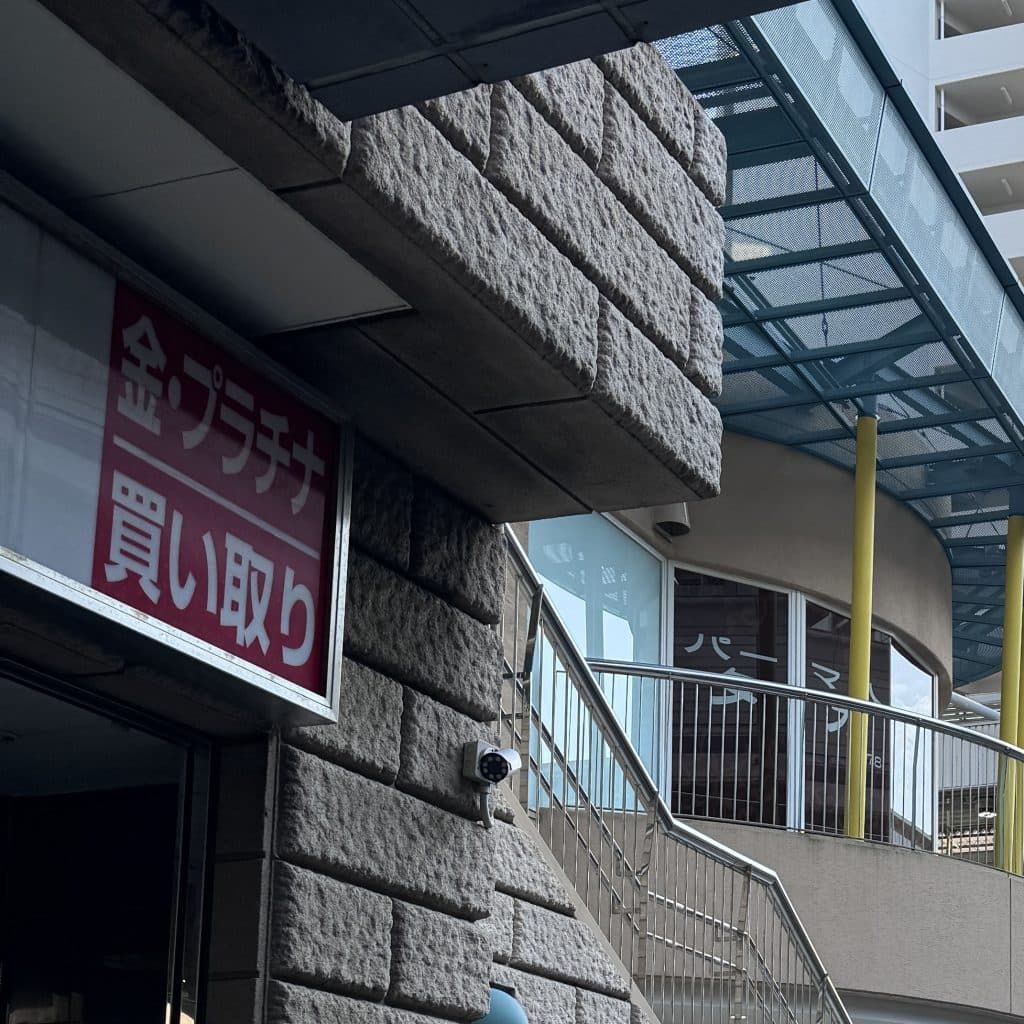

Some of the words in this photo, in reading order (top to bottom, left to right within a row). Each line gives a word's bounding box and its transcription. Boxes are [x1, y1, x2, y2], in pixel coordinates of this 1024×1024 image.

[117, 313, 325, 516] 金・プラチナ
[104, 469, 317, 668] 買い取り
